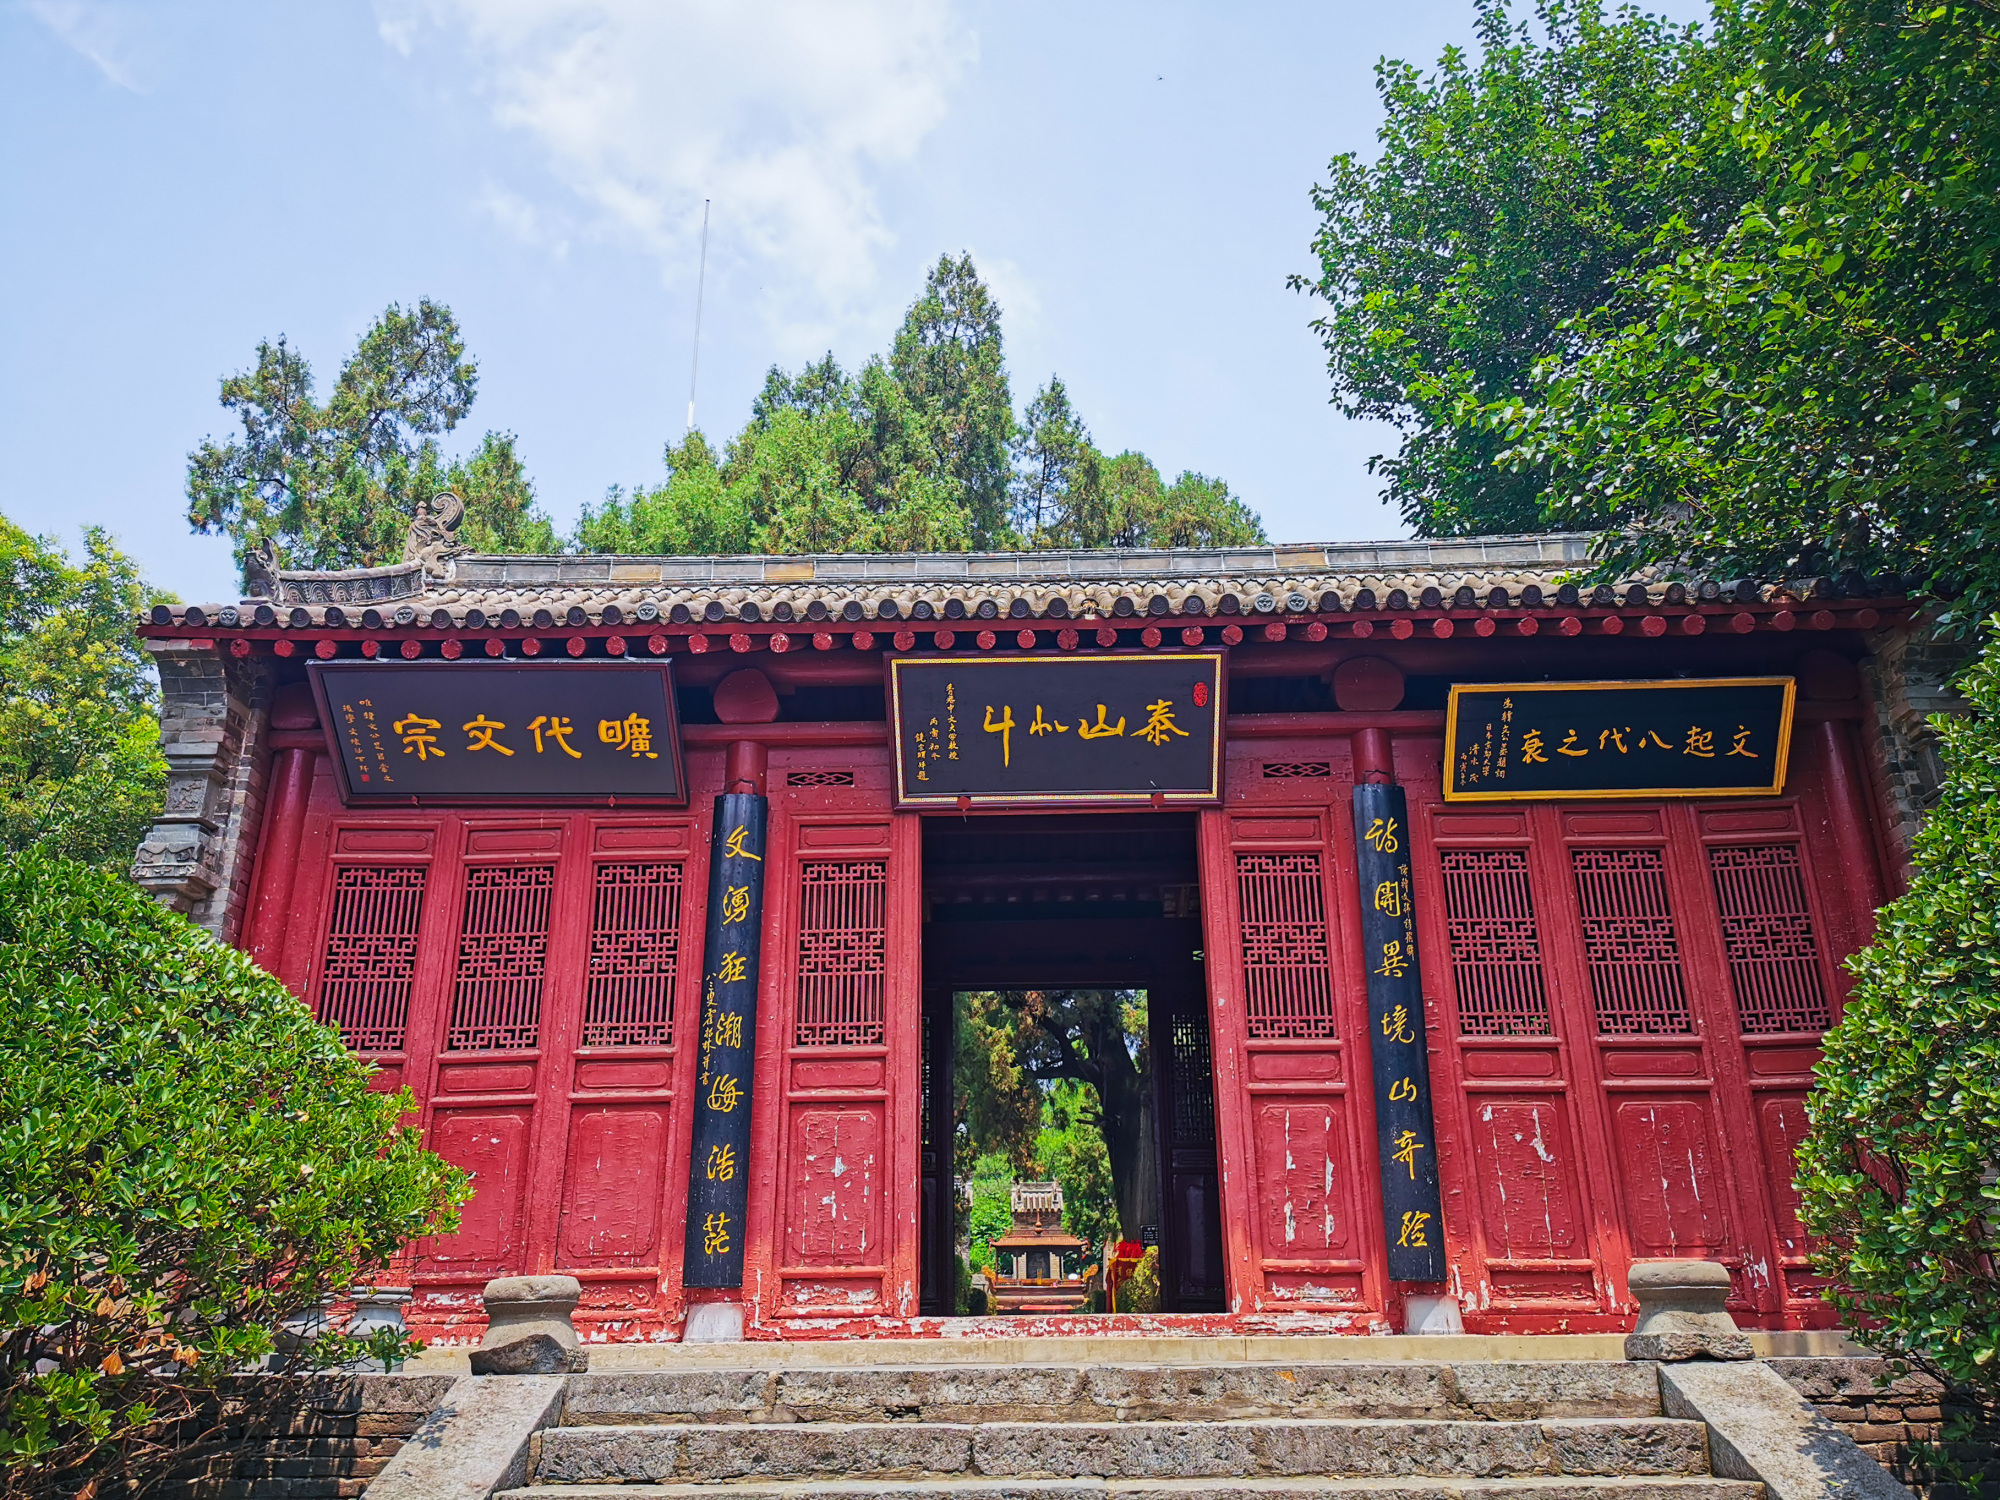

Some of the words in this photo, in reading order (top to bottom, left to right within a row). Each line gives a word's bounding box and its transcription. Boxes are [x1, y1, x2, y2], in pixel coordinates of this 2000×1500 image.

[1520, 724, 1760, 765] 文起八代之衰
